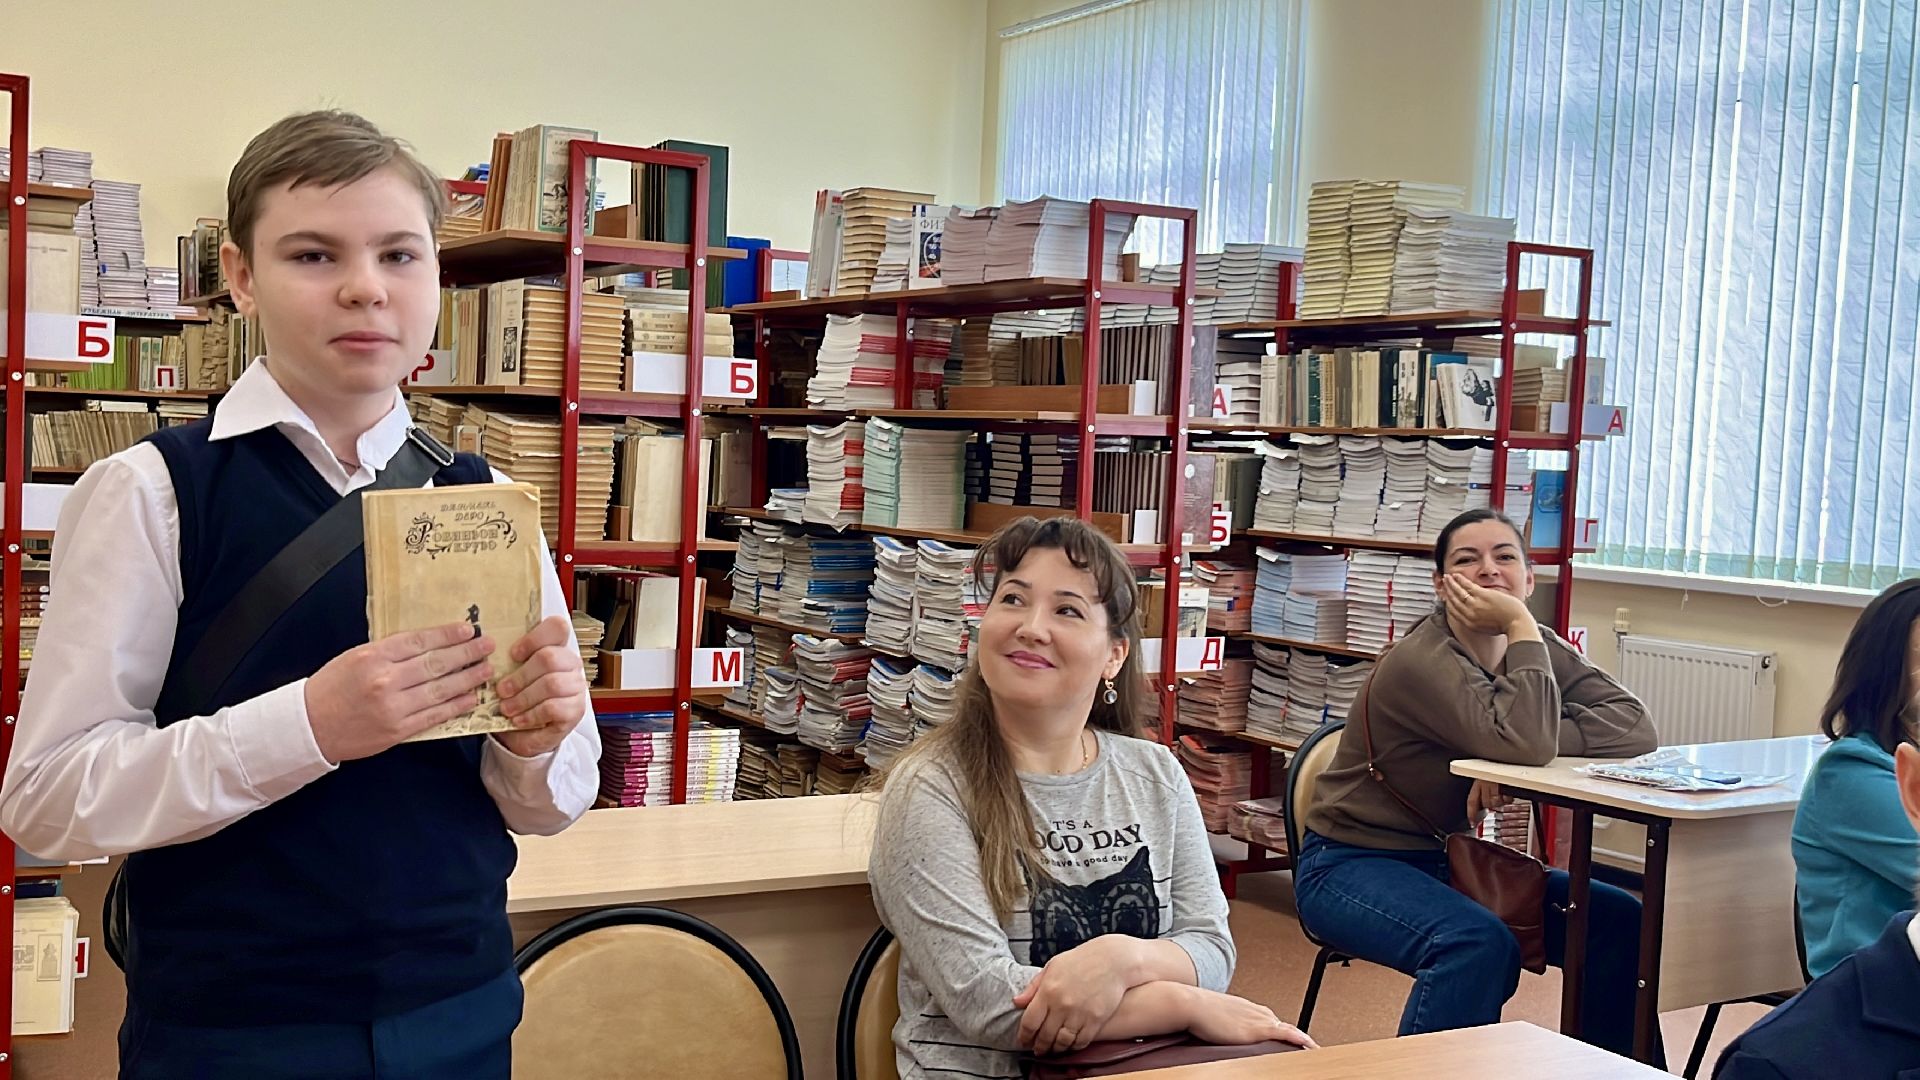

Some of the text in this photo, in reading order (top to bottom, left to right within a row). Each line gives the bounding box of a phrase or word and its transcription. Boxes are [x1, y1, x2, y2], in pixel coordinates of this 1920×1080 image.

[78, 321, 110, 358] Б
[157, 367, 174, 387] П
[731, 362, 755, 394] Б
[1213, 387, 1228, 416] А
[1608, 409, 1624, 433] А
[454, 511, 485, 522] ДЕФО
[1210, 515, 1228, 543] Б
[1584, 519, 1598, 543] Г
[453, 540, 497, 554] КРУЗО
[712, 651, 741, 682] М
[1199, 638, 1221, 670] Д
[1050, 819, 1094, 831] T'S A
[1033, 823, 1144, 854] OOD DAY
[1083, 855, 1108, 868] good
[1111, 854, 1129, 864] day
